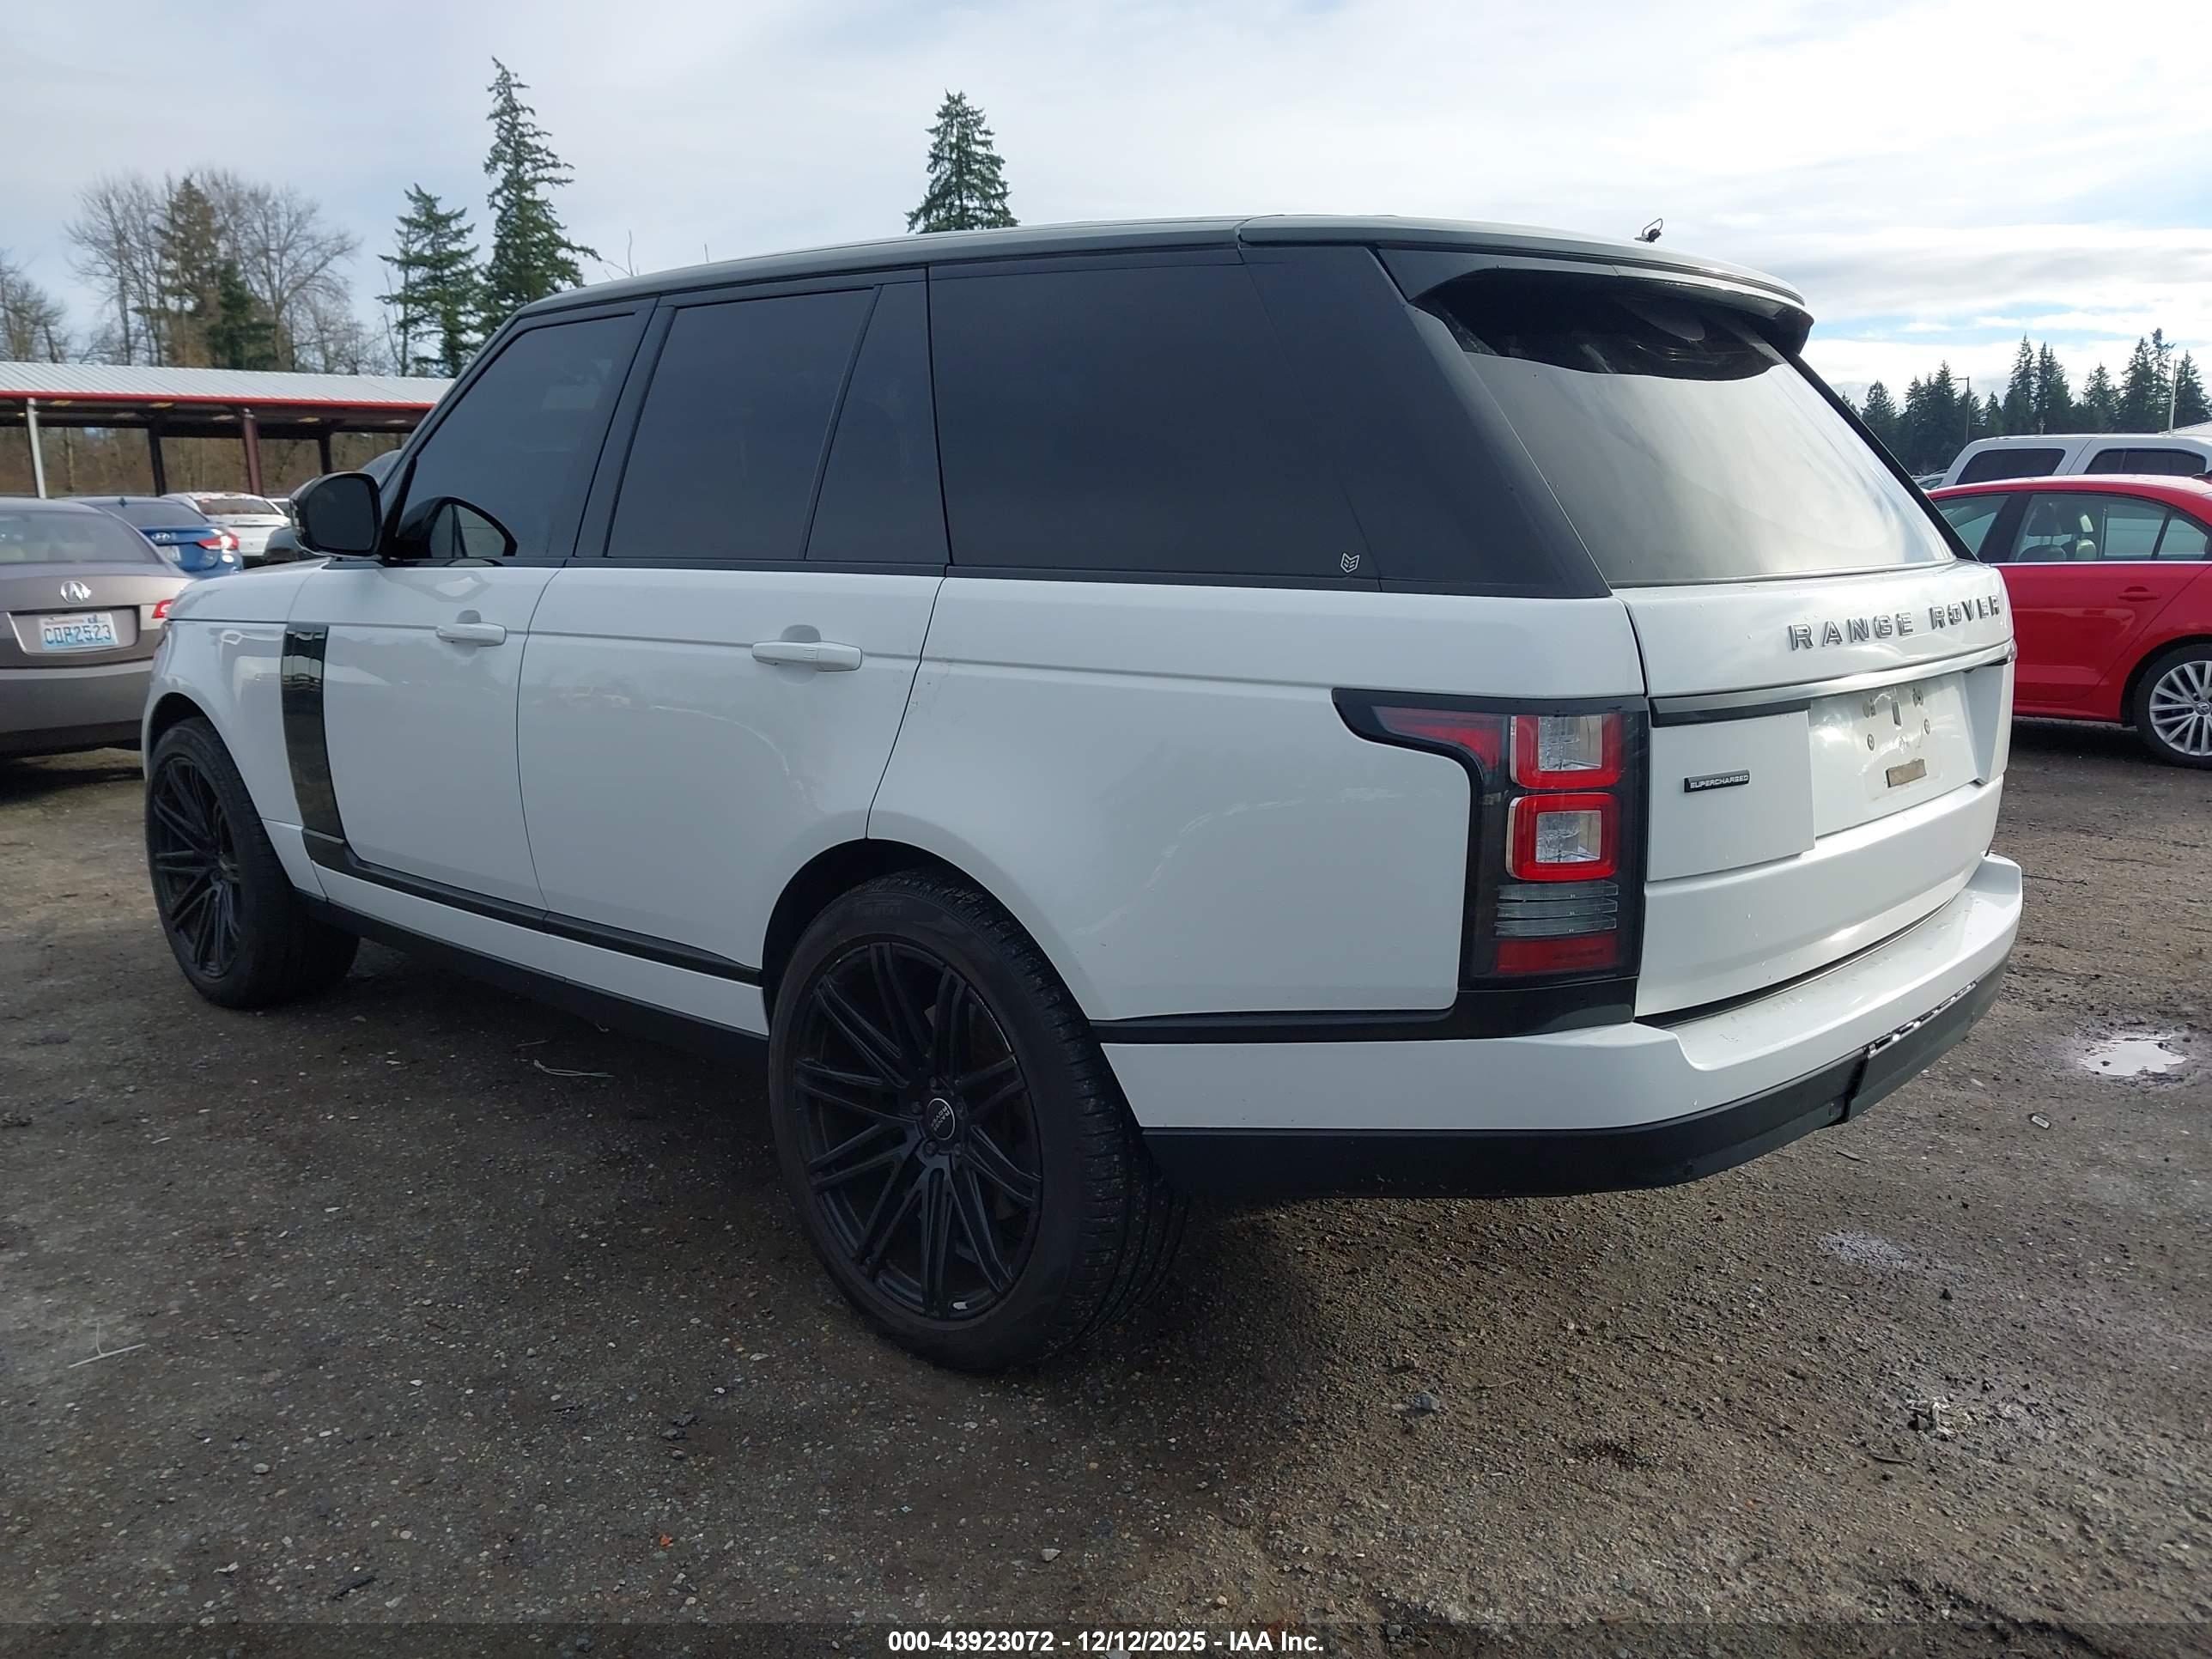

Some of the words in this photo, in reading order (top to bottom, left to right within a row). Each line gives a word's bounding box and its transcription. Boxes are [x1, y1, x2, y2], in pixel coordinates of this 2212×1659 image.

[1787, 611, 1914, 651] RANGE
[1929, 595, 2000, 629] ROVER
[1689, 775, 1749, 789] SUPERCHARGED
